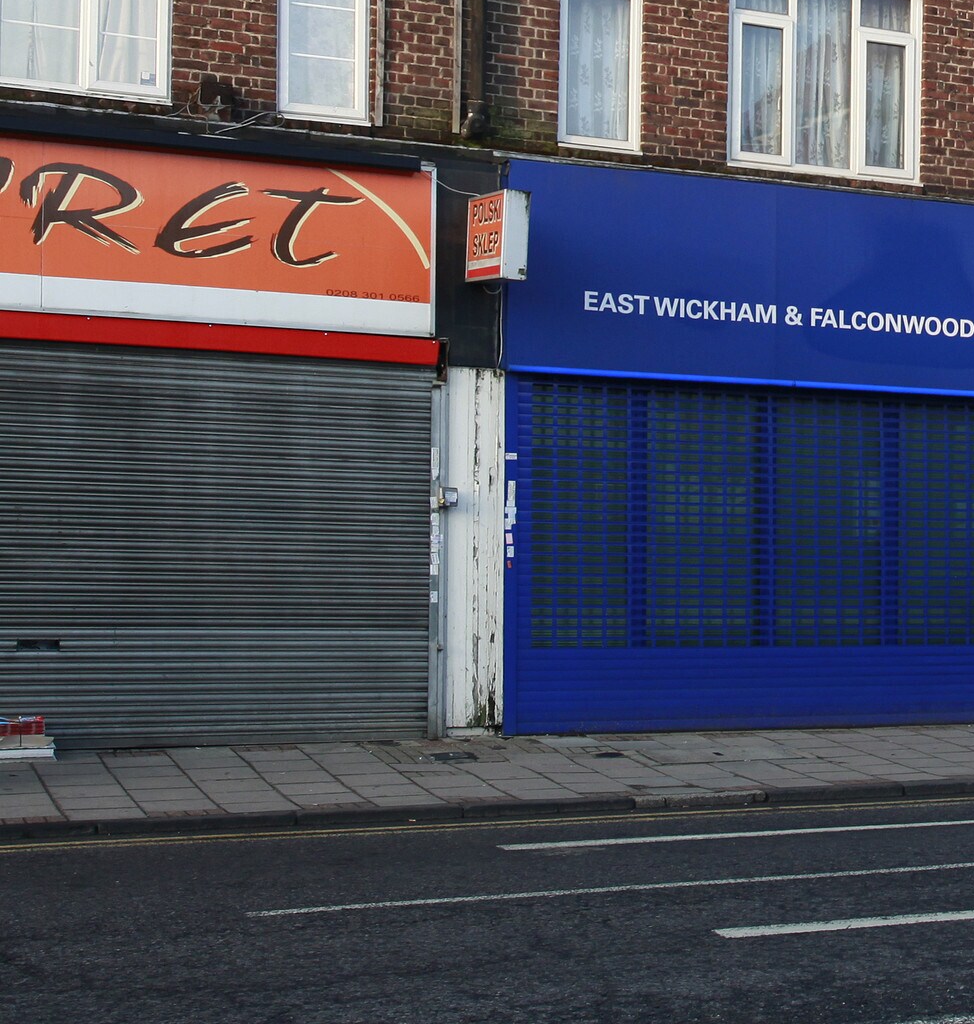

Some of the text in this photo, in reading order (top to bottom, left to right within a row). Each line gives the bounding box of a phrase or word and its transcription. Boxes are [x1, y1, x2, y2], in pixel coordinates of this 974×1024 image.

[0, 156, 365, 268] RET
[472, 231, 499, 258] SKLEP
[326, 289, 420, 303] 0208 301 0566
[584, 290, 650, 315] EAST
[653, 296, 777, 324] WICKHAM
[784, 305, 803, 326] &
[810, 307, 974, 338] FALCONWOOD
